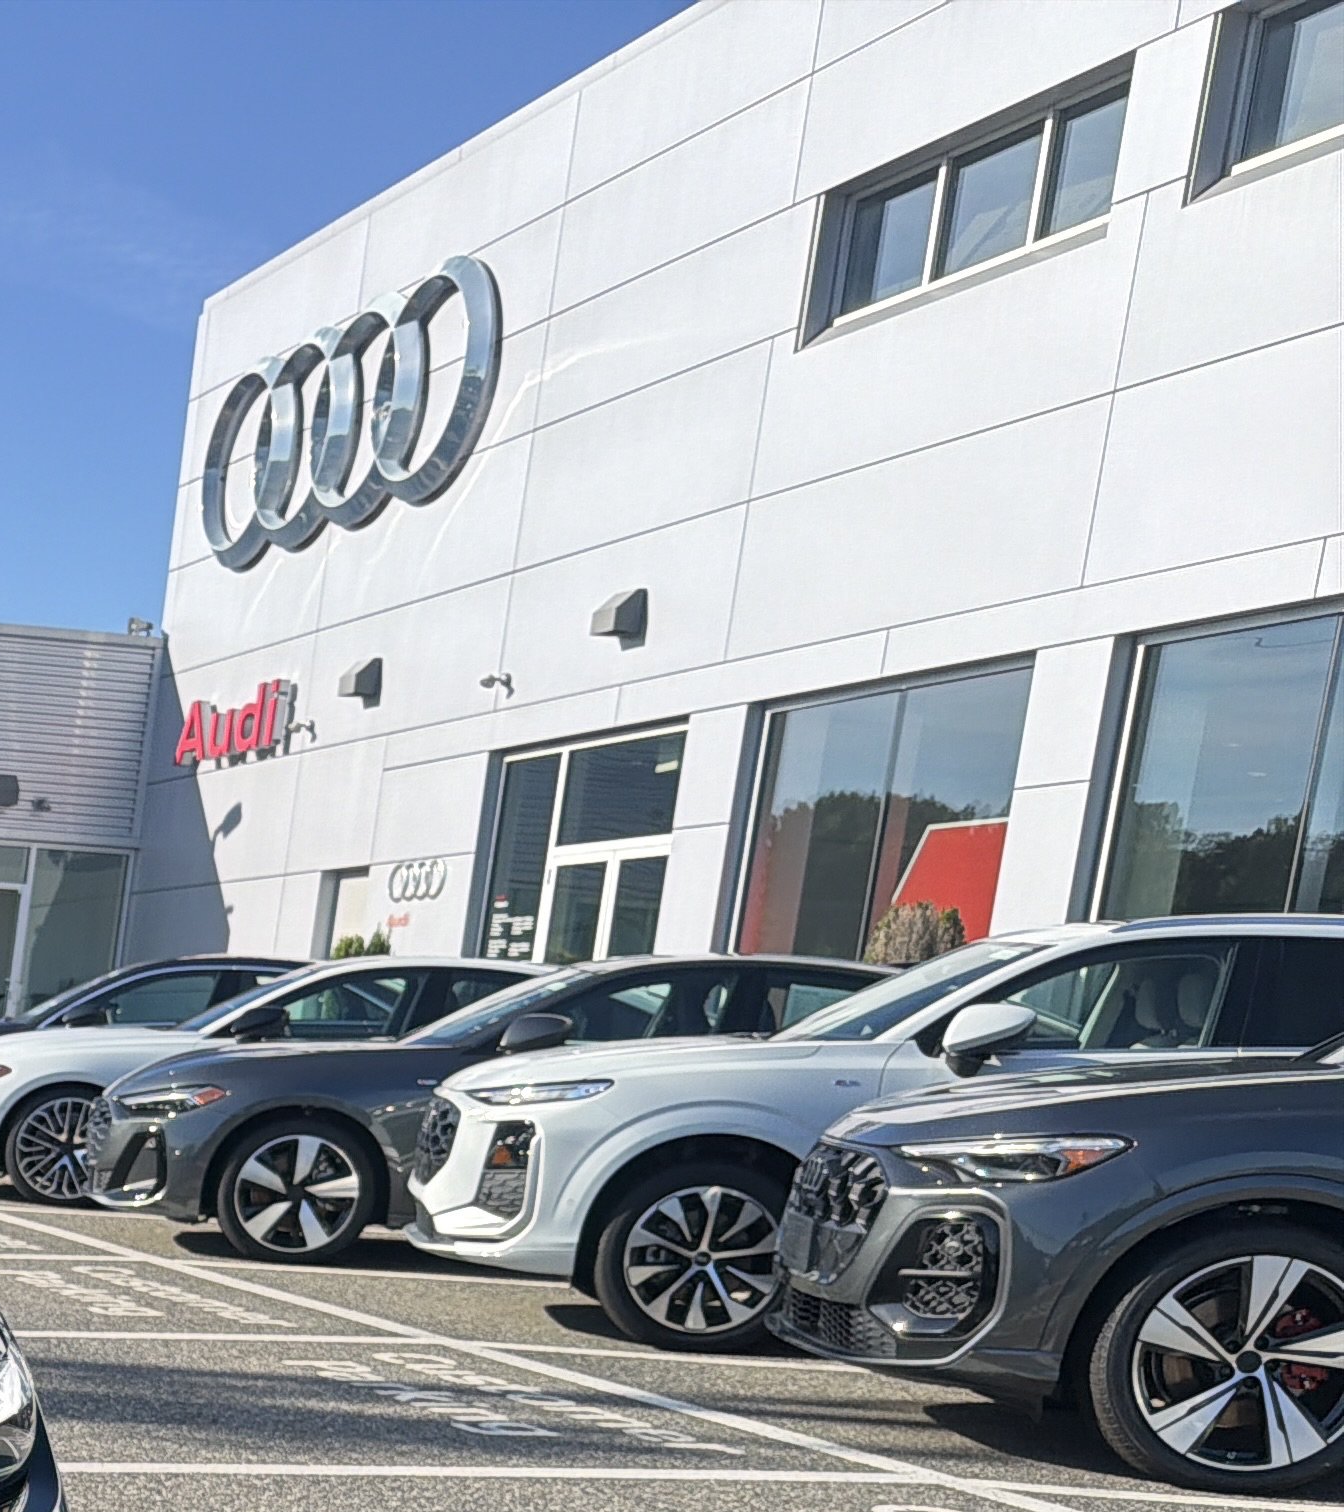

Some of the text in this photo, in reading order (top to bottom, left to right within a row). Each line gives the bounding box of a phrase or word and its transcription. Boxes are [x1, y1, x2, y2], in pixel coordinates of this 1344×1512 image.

[174, 678, 285, 767] Audi
[282, 1359, 562, 1437] Parking
[372, 1352, 747, 1455] Customer
